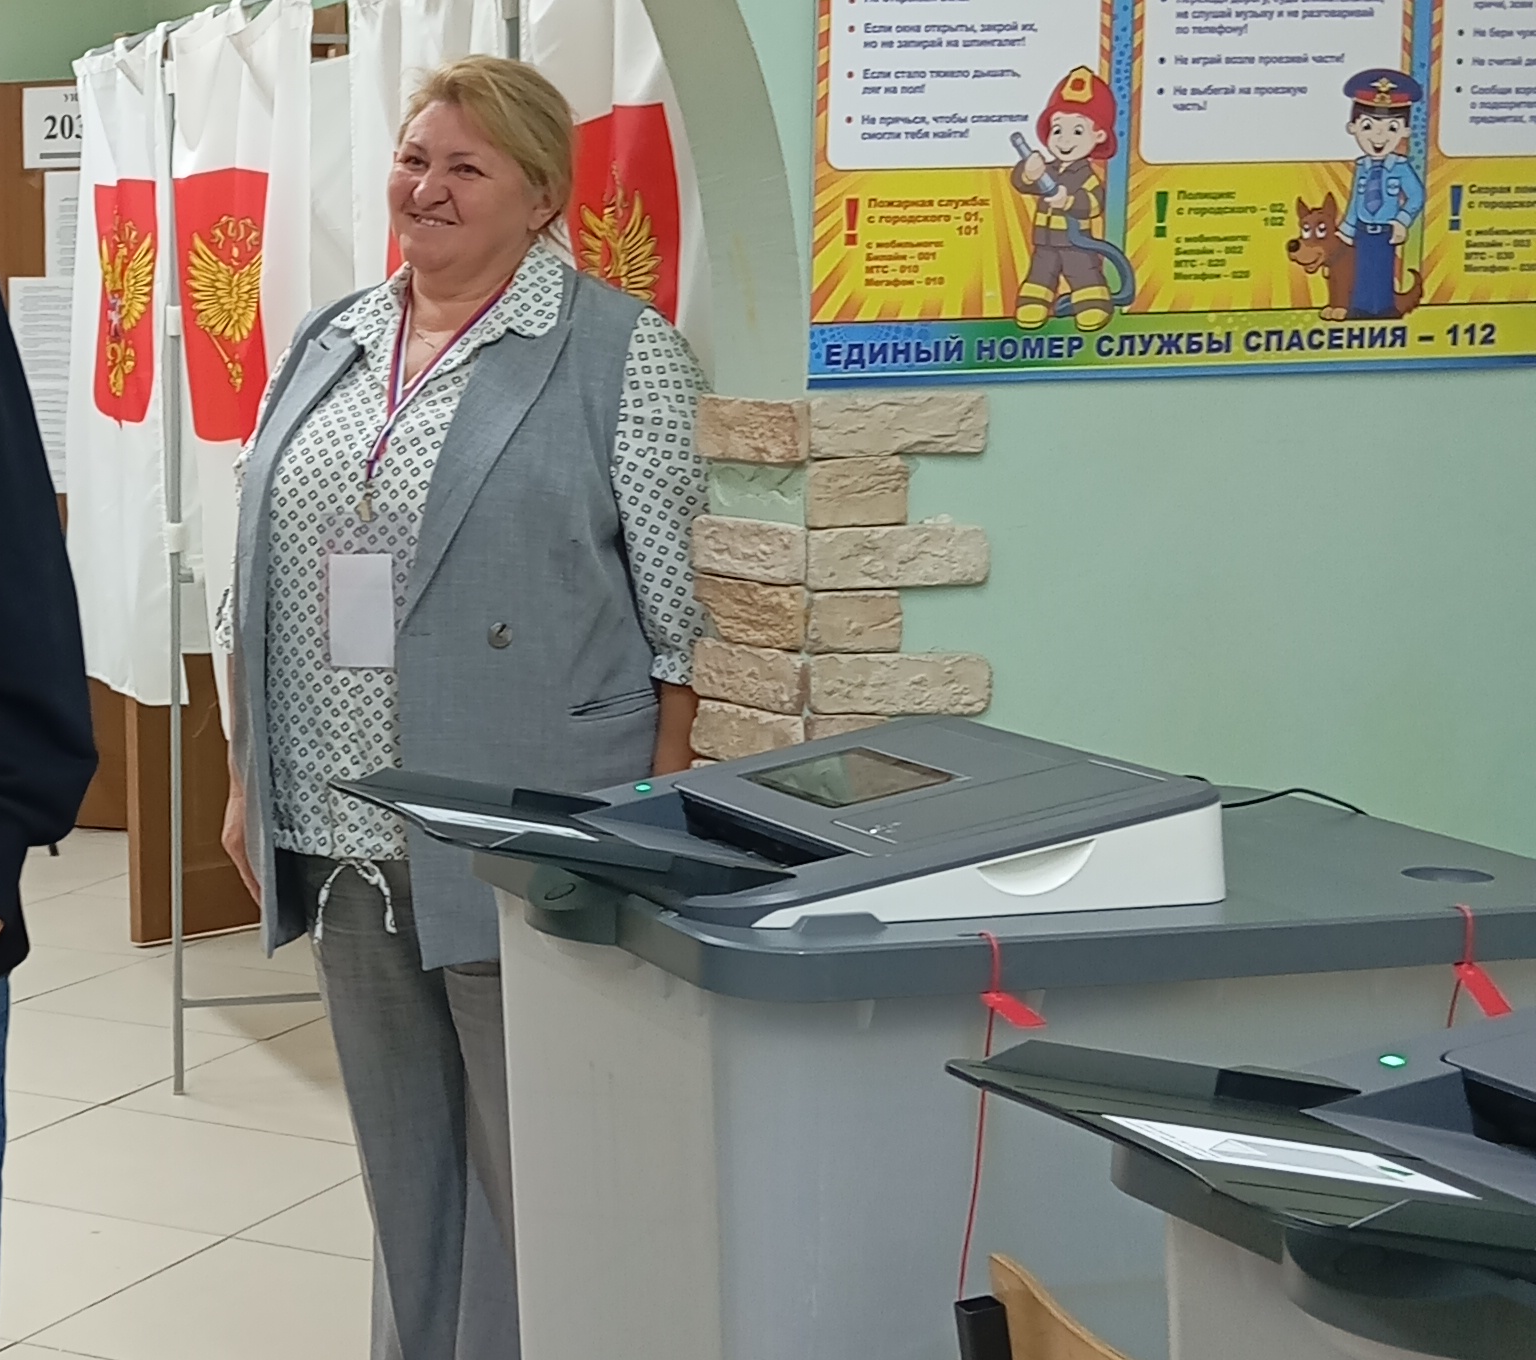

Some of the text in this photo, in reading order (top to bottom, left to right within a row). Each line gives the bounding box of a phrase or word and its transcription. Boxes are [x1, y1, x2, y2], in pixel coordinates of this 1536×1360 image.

[864, 23, 892, 33] Если
[1174, 55, 1189, 65] Не
[863, 69, 891, 79] Если
[1173, 86, 1188, 96] Не
[861, 115, 876, 125] Не
[932, 114, 967, 124] чтобы
[904, 130, 929, 139] тебя
[868, 197, 990, 209] Пожарная служба:
[1187, 206, 1257, 217] городского
[867, 212, 983, 225] с городского 01,
[1263, 217, 1285, 226] 102
[956, 226, 978, 235] 101
[824, 333, 963, 370] ЕДИНЫЙ
[975, 331, 1083, 360] НОМЕР
[1095, 327, 1232, 358] СЛУЖБЫ
[1243, 326, 1407, 352] СПАСЕНИЯ
[1446, 323, 1497, 346] 112
